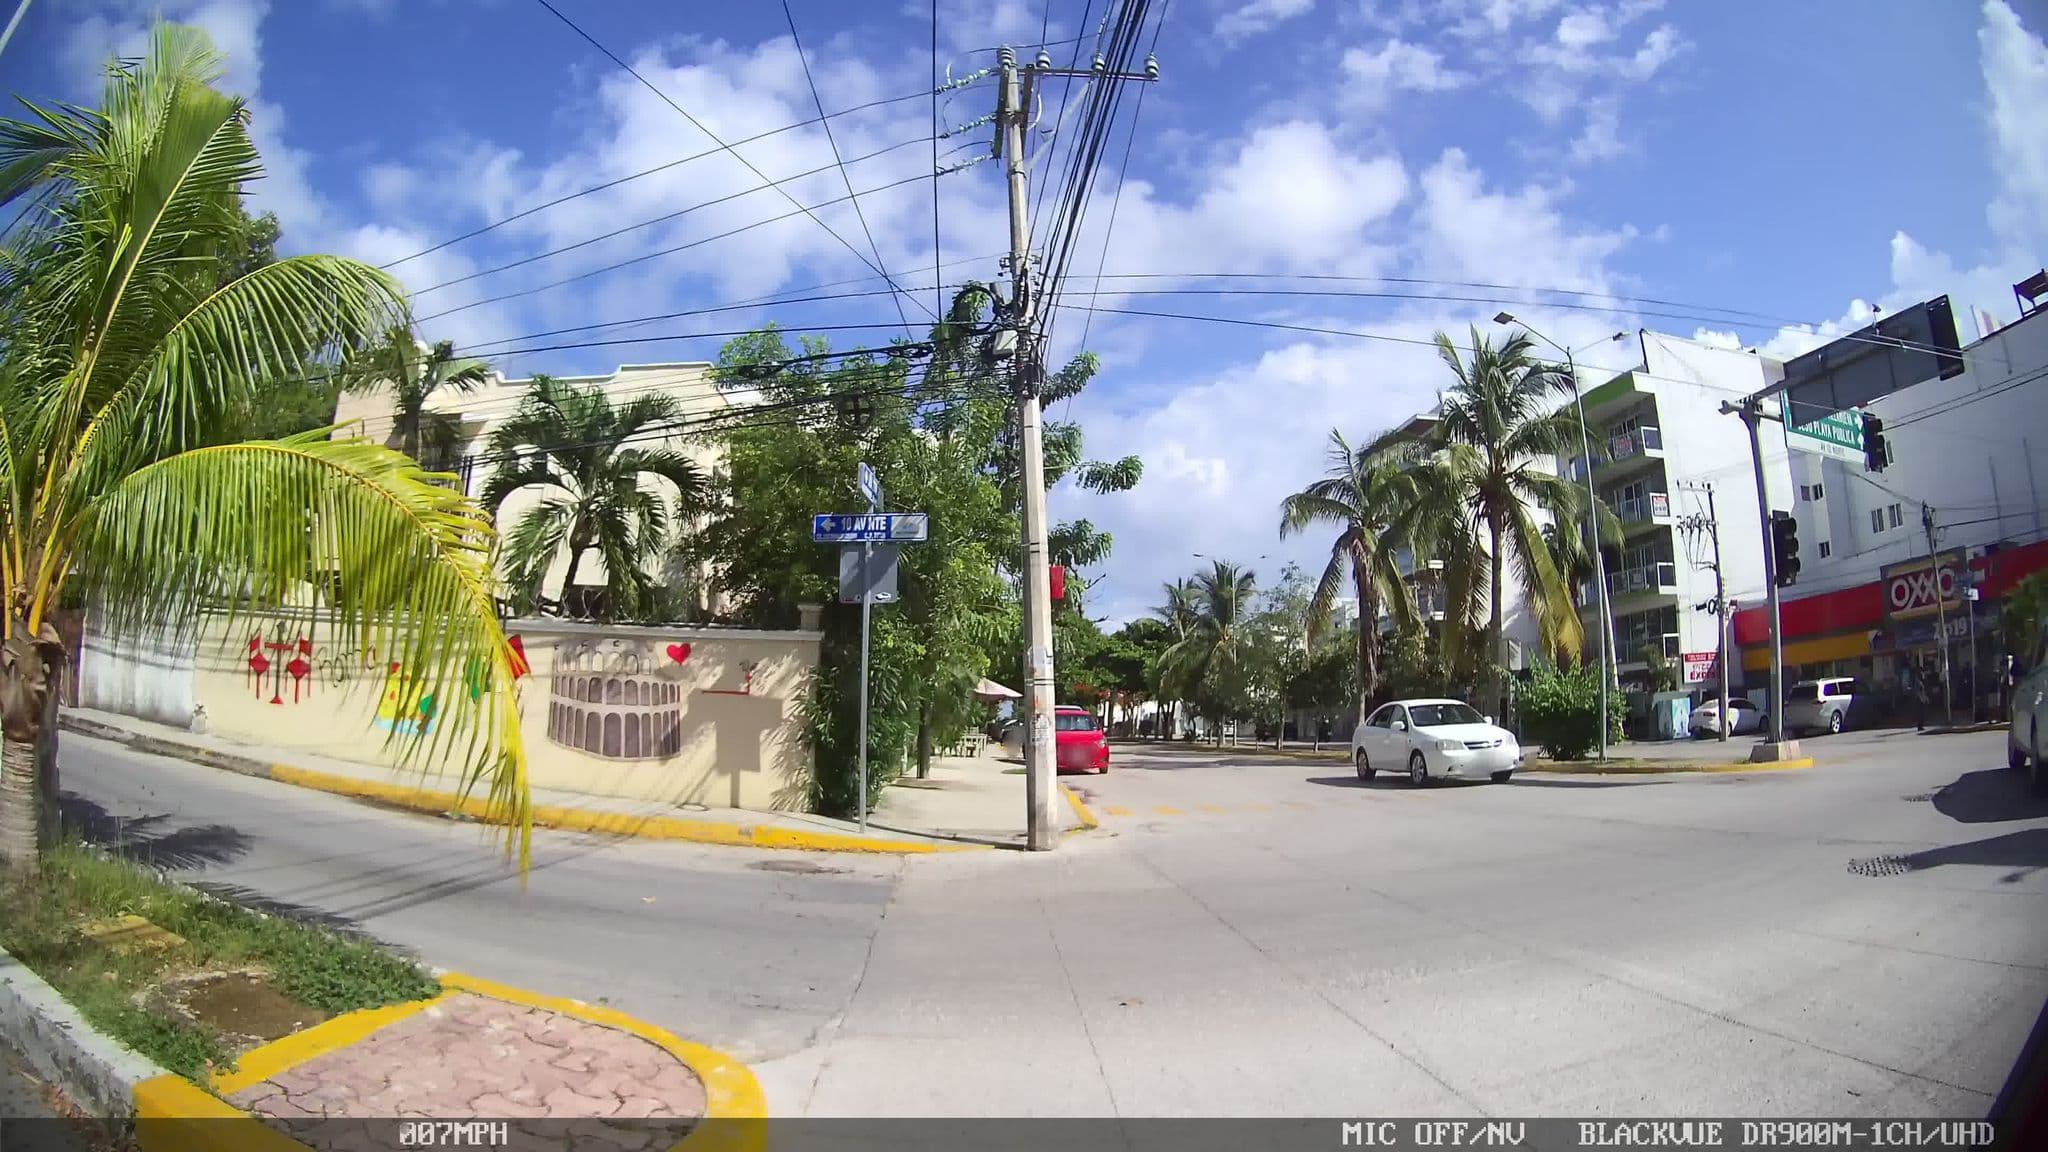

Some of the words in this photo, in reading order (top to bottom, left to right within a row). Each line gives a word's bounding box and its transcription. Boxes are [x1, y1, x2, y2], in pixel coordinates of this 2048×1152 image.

[842, 517, 852, 531] 10
[854, 517, 867, 531] AV
[868, 516, 887, 531] NTE
[1891, 568, 1955, 609] OXXO
